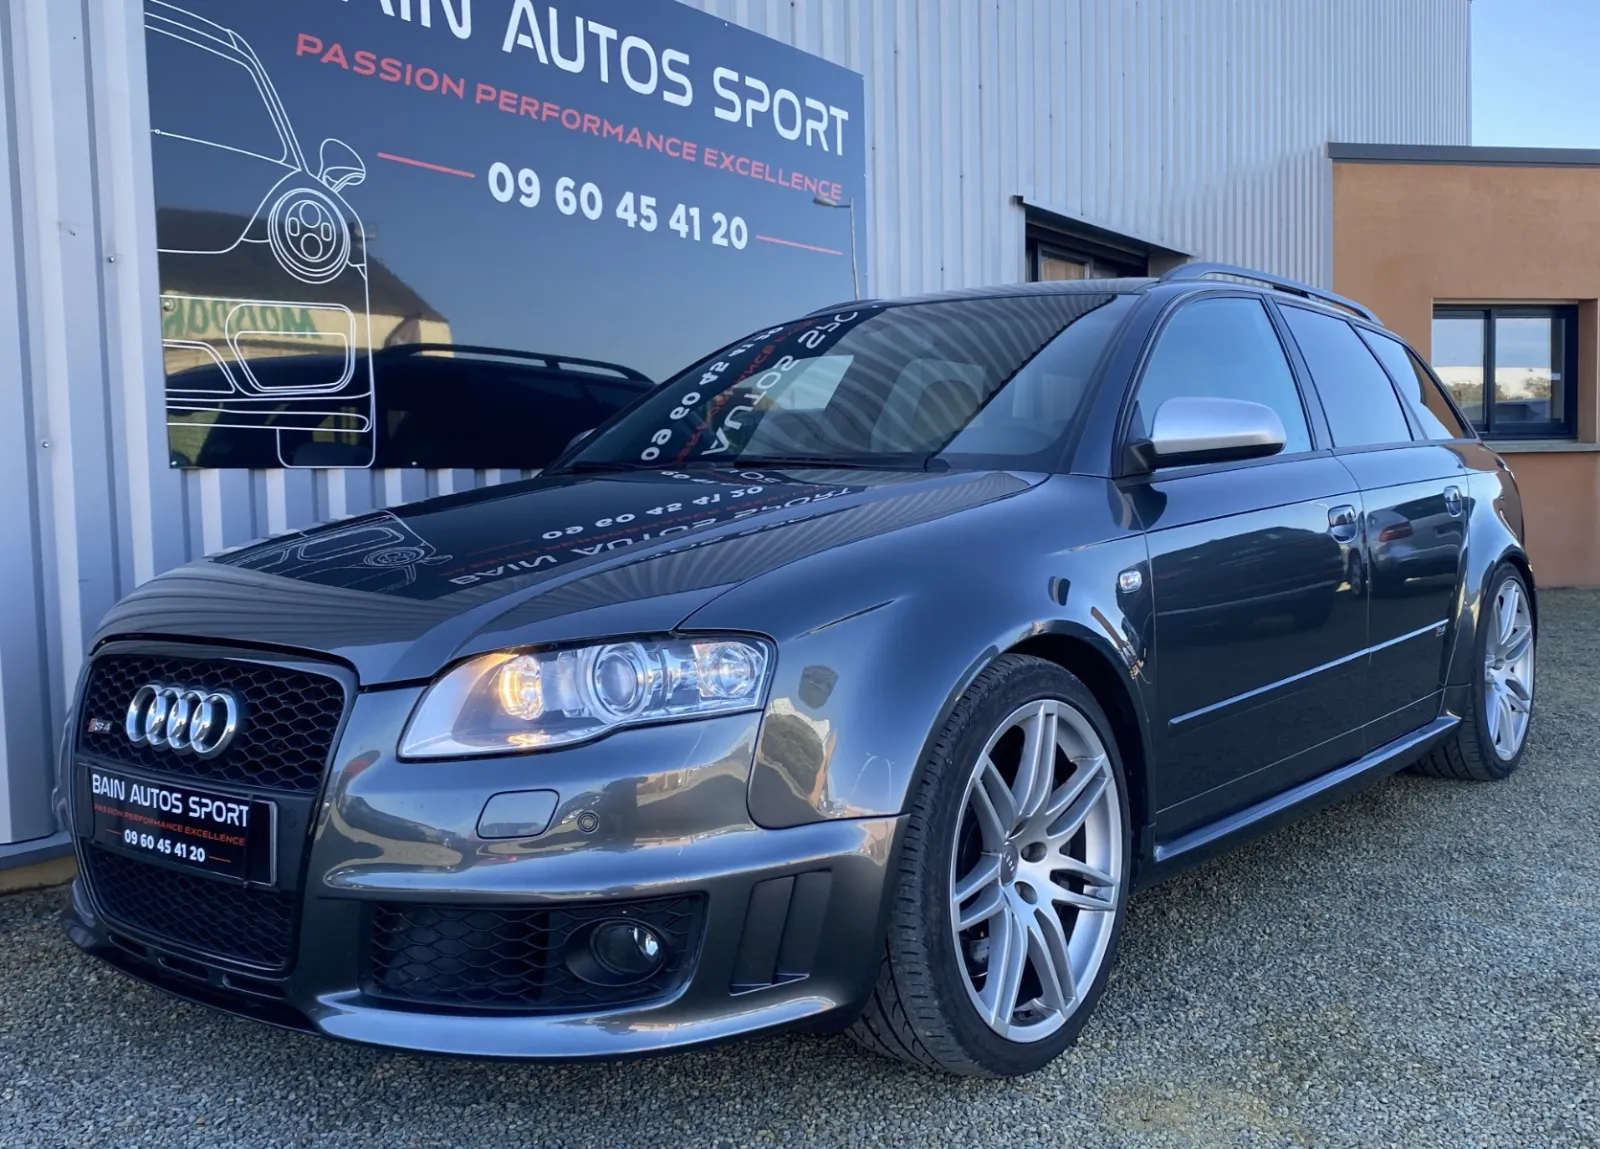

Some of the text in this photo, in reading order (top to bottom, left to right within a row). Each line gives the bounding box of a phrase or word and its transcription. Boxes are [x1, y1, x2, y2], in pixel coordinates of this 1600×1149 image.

[502, 0, 849, 156] AUTOS SPORT
[295, 33, 842, 200] PASSION PERFORMANCE EXCELLENCE
[488, 162, 748, 250] 09 60 45 41 20
[92, 774, 249, 827] BAIN AUTOS SPORT
[94, 803, 245, 846] PASSION PERFORMANCE EXCELLENCE
[124, 829, 206, 862] 09 60 45 41 20
